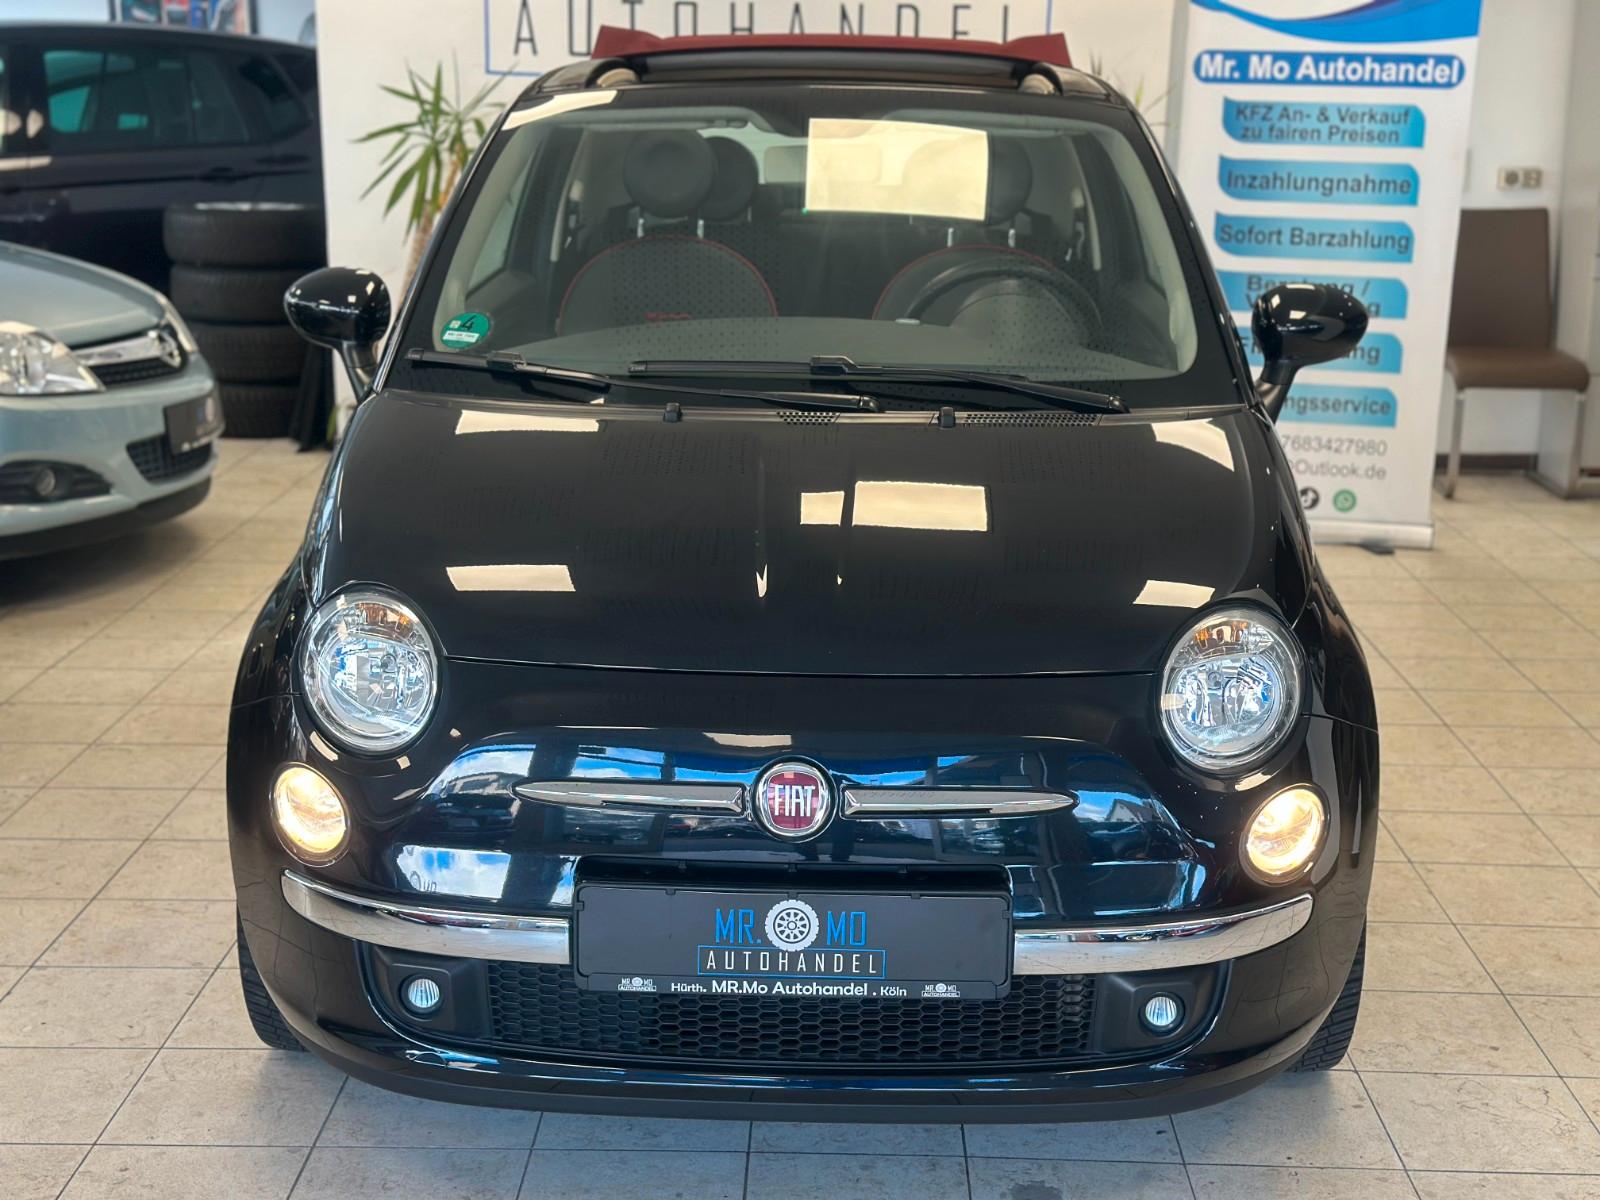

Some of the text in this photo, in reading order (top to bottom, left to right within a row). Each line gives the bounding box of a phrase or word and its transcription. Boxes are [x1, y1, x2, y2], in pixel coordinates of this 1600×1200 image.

[1200, 54, 1460, 84] Mr. Mo Autohandel
[1235, 105, 1411, 125] KFZ An- & Verkauf
[1241, 126, 1400, 143] zu fairen Preisen
[1226, 170, 1413, 197] Inzahlungnahme
[1219, 224, 1410, 254] Sofort Barzahlung
[462, 314, 477, 331] 4
[1284, 396, 1392, 416] ngsservice
[1280, 435, 1389, 457] 7683427980
[774, 784, 816, 817] FIAT
[715, 908, 867, 946] MR. MO
[706, 950, 877, 974] AUTOHANDEL
[671, 982, 707, 993] Hürth.
[712, 979, 769, 994] MR.Mo
[772, 980, 868, 996] Autohandel
[880, 985, 907, 997] Köln
